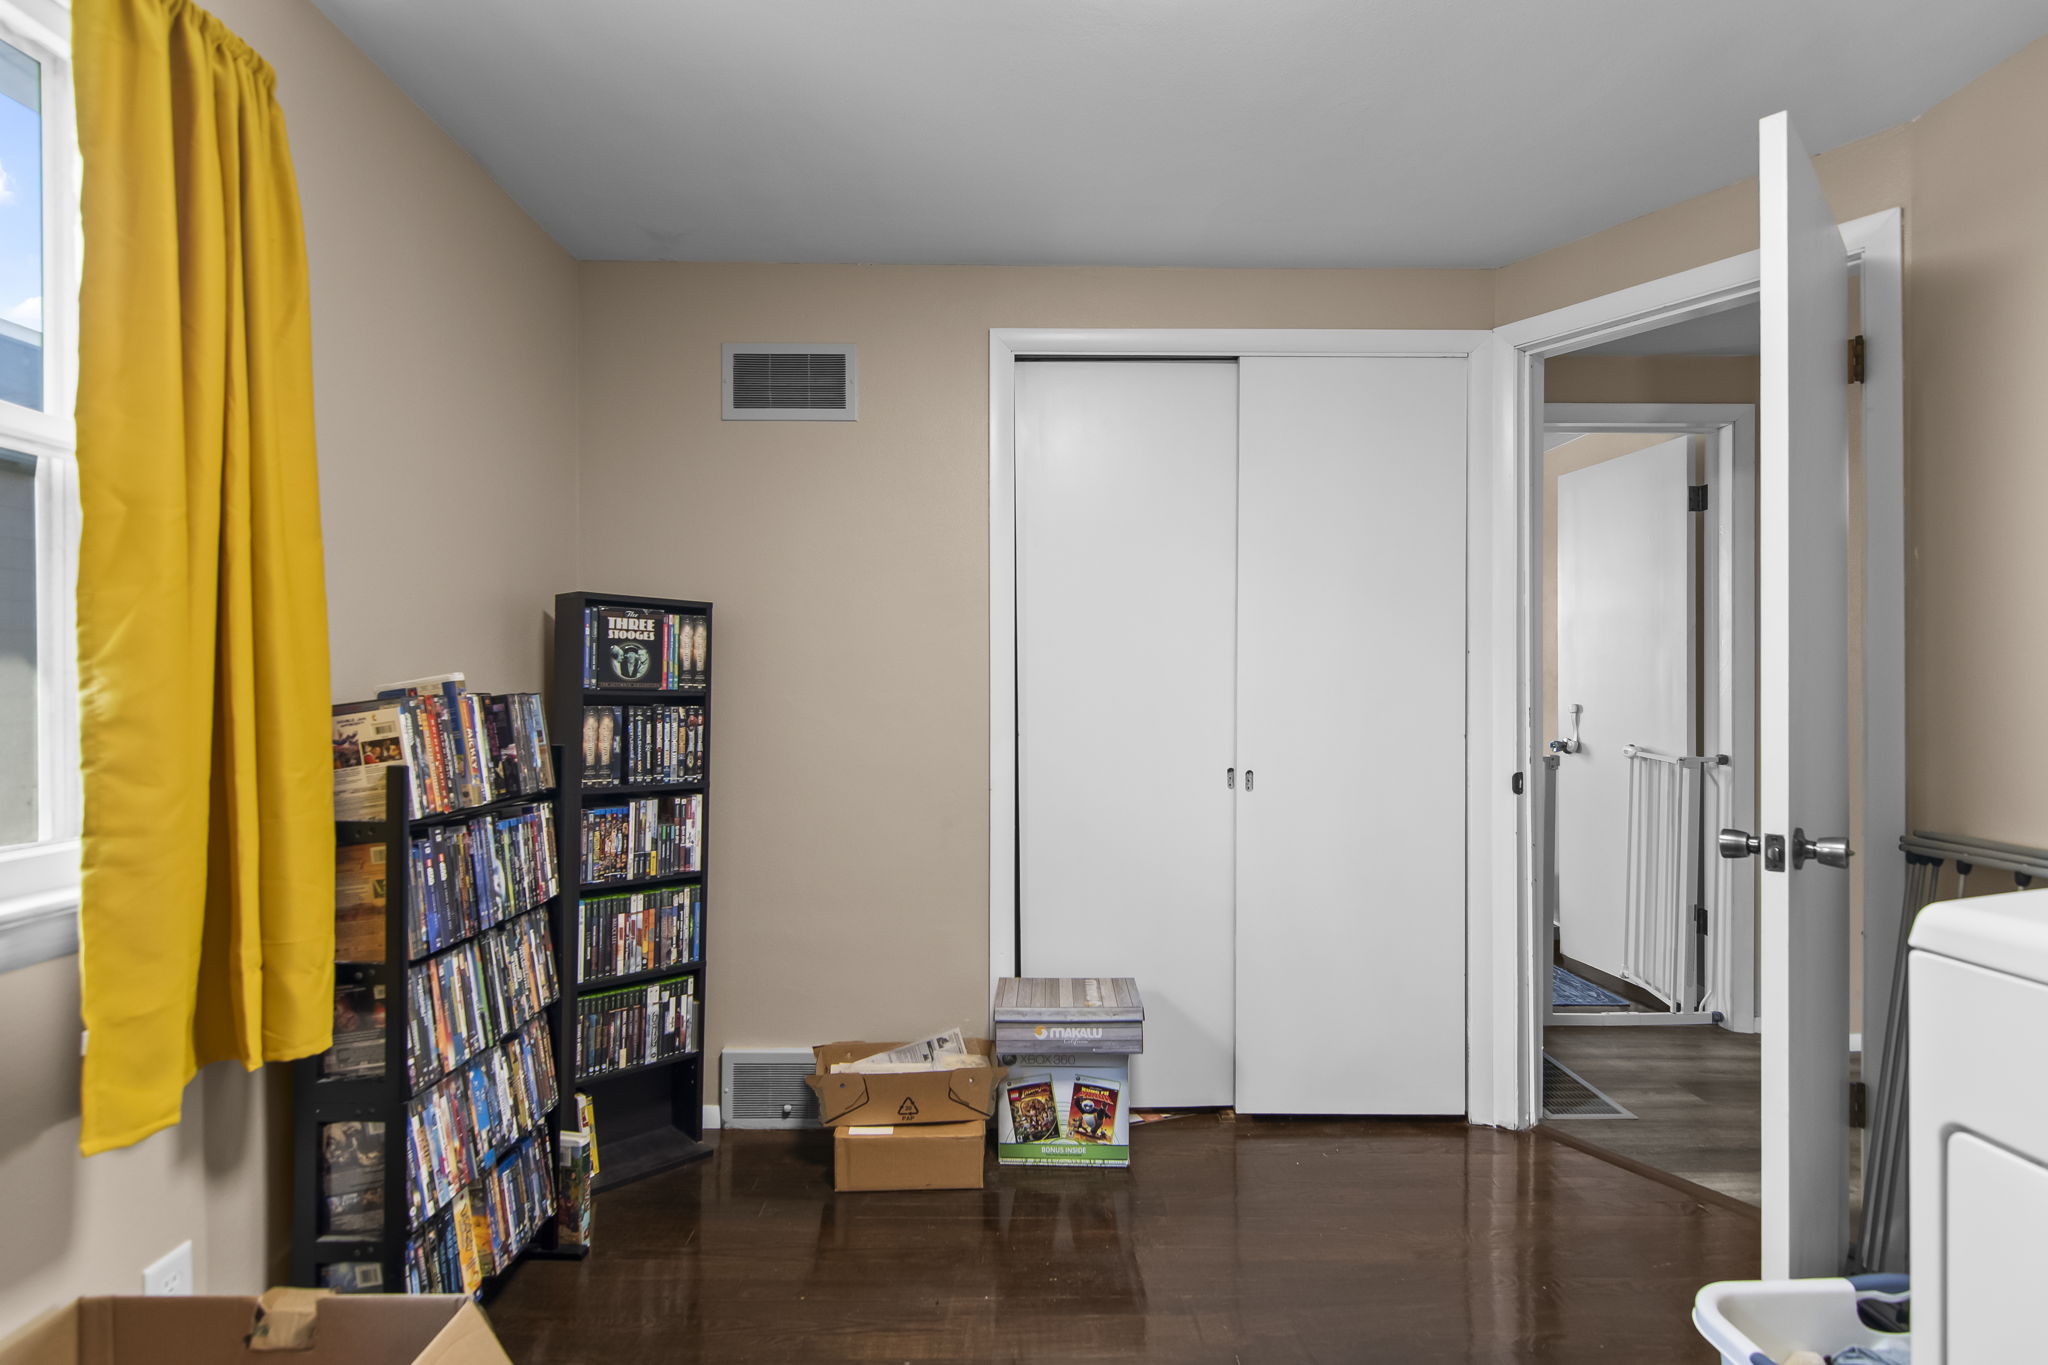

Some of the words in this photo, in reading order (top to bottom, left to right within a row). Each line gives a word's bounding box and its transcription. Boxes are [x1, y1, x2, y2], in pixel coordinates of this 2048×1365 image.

[625, 610, 639, 618] The
[607, 617, 655, 631] THREE
[607, 629, 655, 640] STOOGES
[465, 728, 479, 769] MICKEY
[1050, 1027, 1102, 1039] MAKALU
[1019, 1054, 1052, 1065] XBOX
[1053, 1054, 1075, 1065] 360
